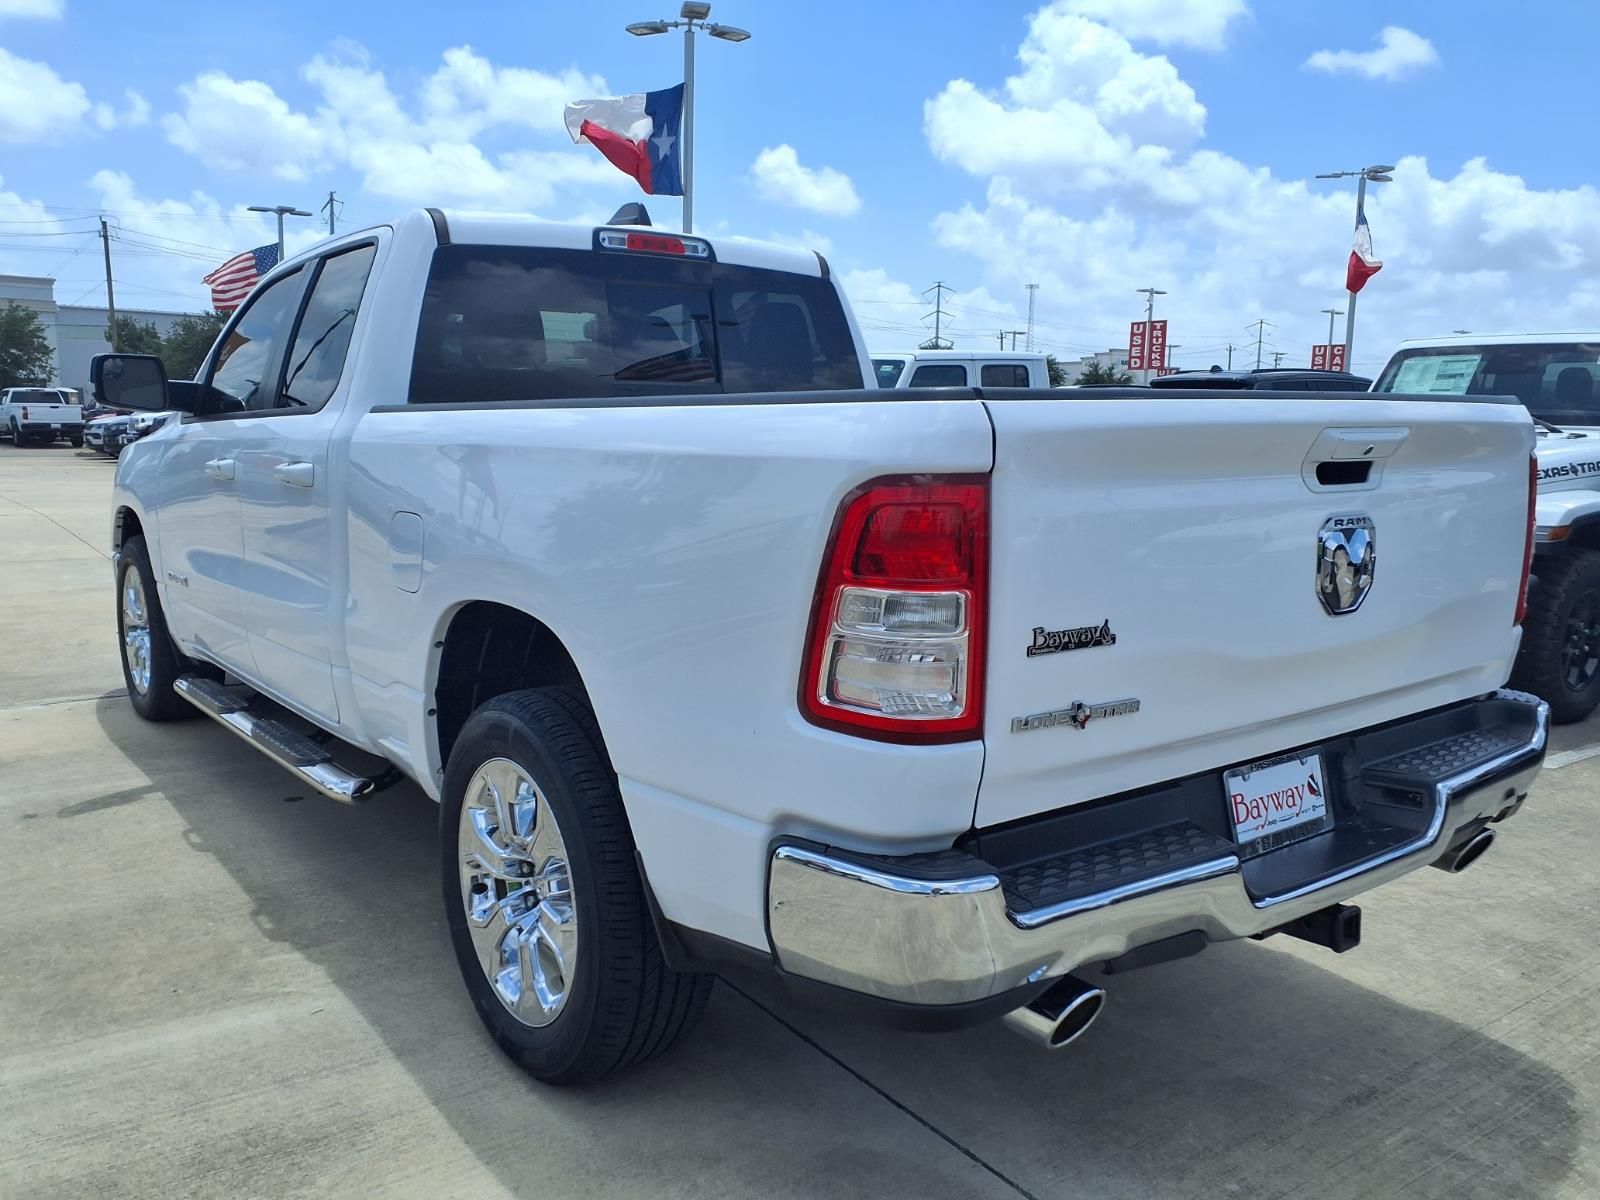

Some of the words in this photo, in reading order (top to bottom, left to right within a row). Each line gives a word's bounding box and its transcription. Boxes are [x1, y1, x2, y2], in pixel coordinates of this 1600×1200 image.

[1130, 324, 1144, 368] USED
[1151, 322, 1164, 367] TRUCKS
[1313, 346, 1325, 370] US
[1332, 346, 1343, 371] CAR
[1536, 465, 1570, 480] EXAS
[1333, 517, 1368, 527] RAM
[1032, 626, 1101, 654] Bayway
[1011, 711, 1072, 733] LONE
[1089, 699, 1141, 719] STAR
[1231, 784, 1305, 829] Bayway
